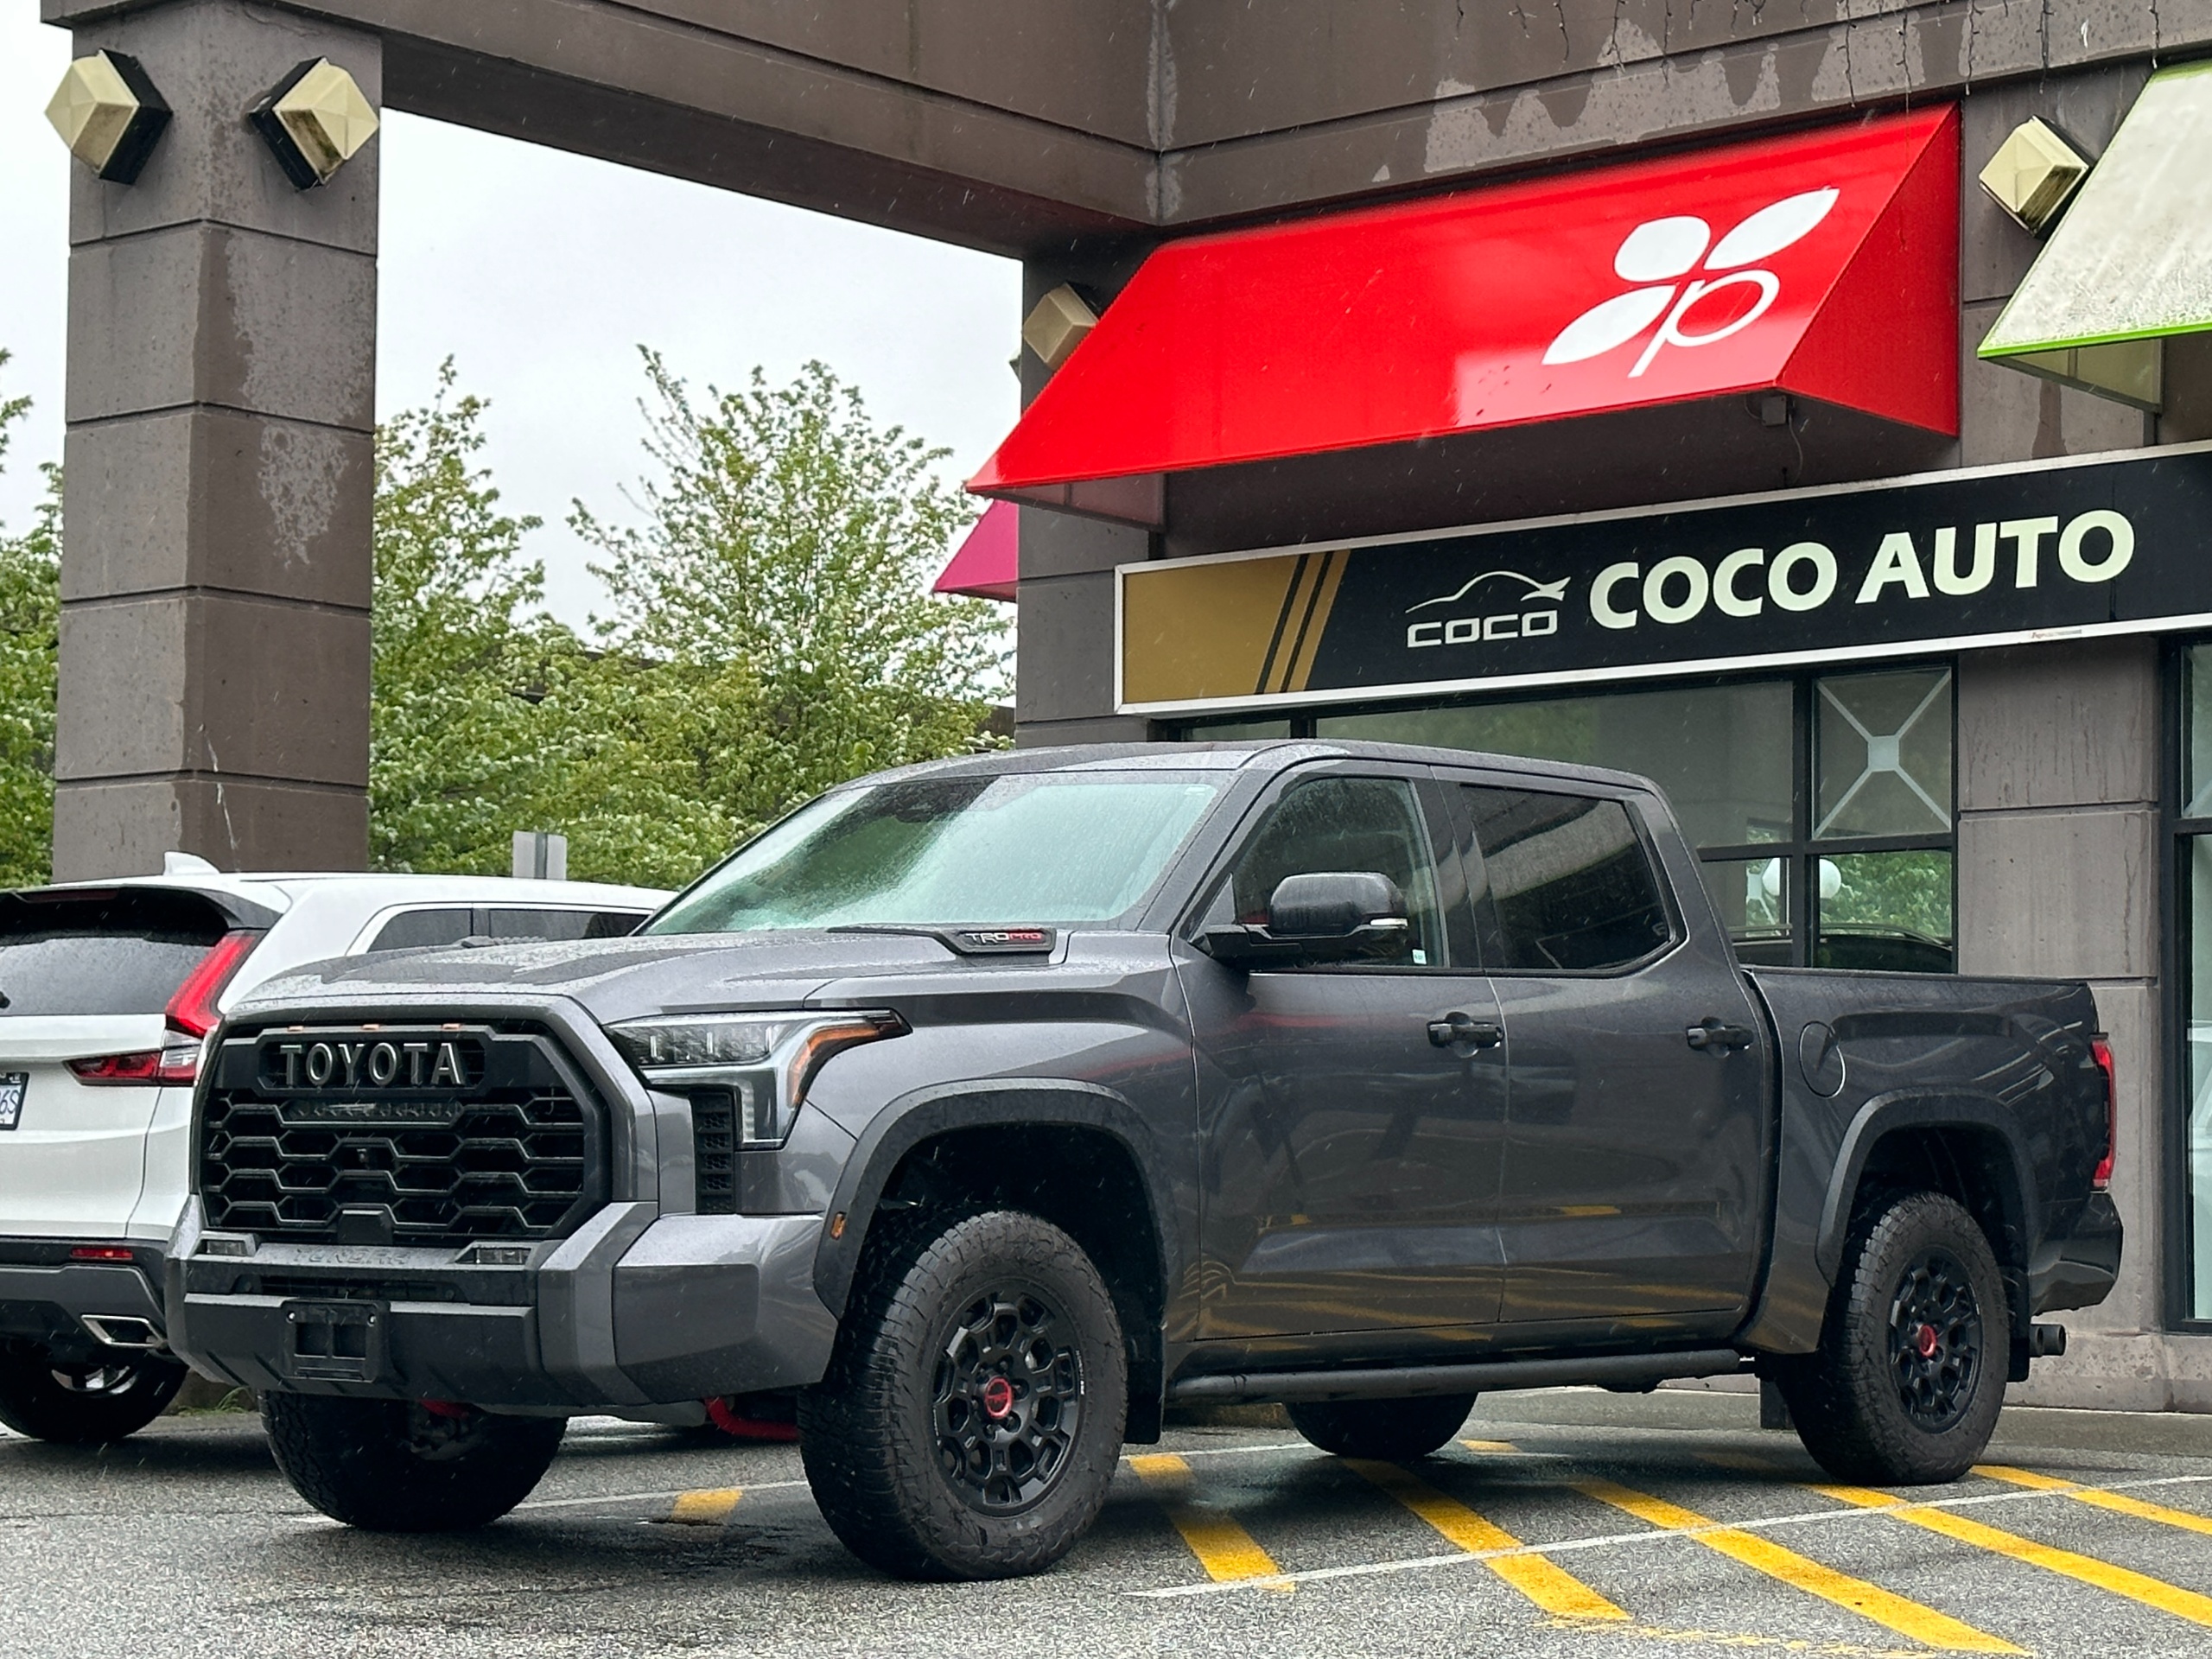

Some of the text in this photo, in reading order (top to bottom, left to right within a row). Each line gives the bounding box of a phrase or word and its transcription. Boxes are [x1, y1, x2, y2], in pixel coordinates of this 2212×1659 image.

[1590, 510, 2134, 628] COCO AUTO
[1407, 609, 1558, 648] COCO
[280, 1042, 465, 1087] TOYOTA
